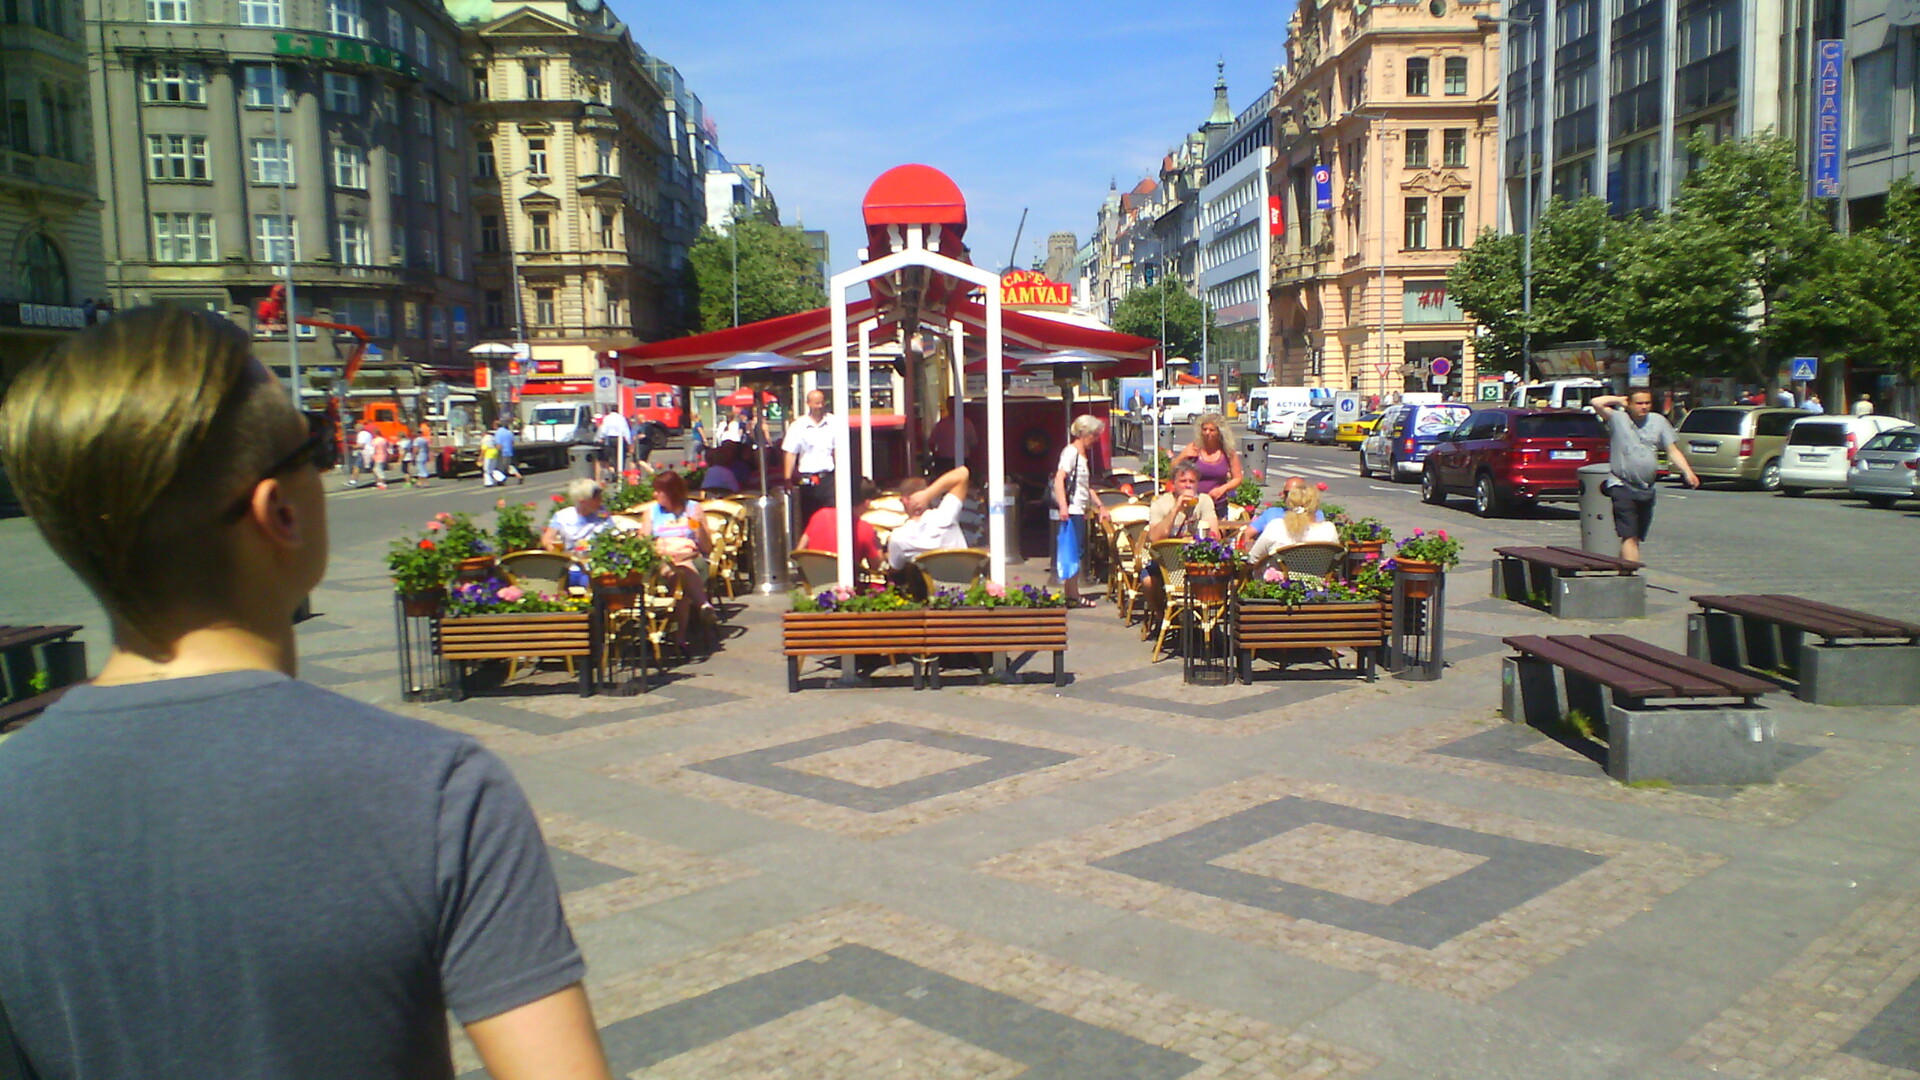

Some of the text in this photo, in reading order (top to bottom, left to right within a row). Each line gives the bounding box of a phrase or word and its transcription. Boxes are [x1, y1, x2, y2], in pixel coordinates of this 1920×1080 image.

[1820, 43, 1839, 168] CABARET
[1002, 271, 1045, 287] CAFE
[979, 286, 1068, 304] RAMVAJ
[1635, 355, 1645, 368] P
